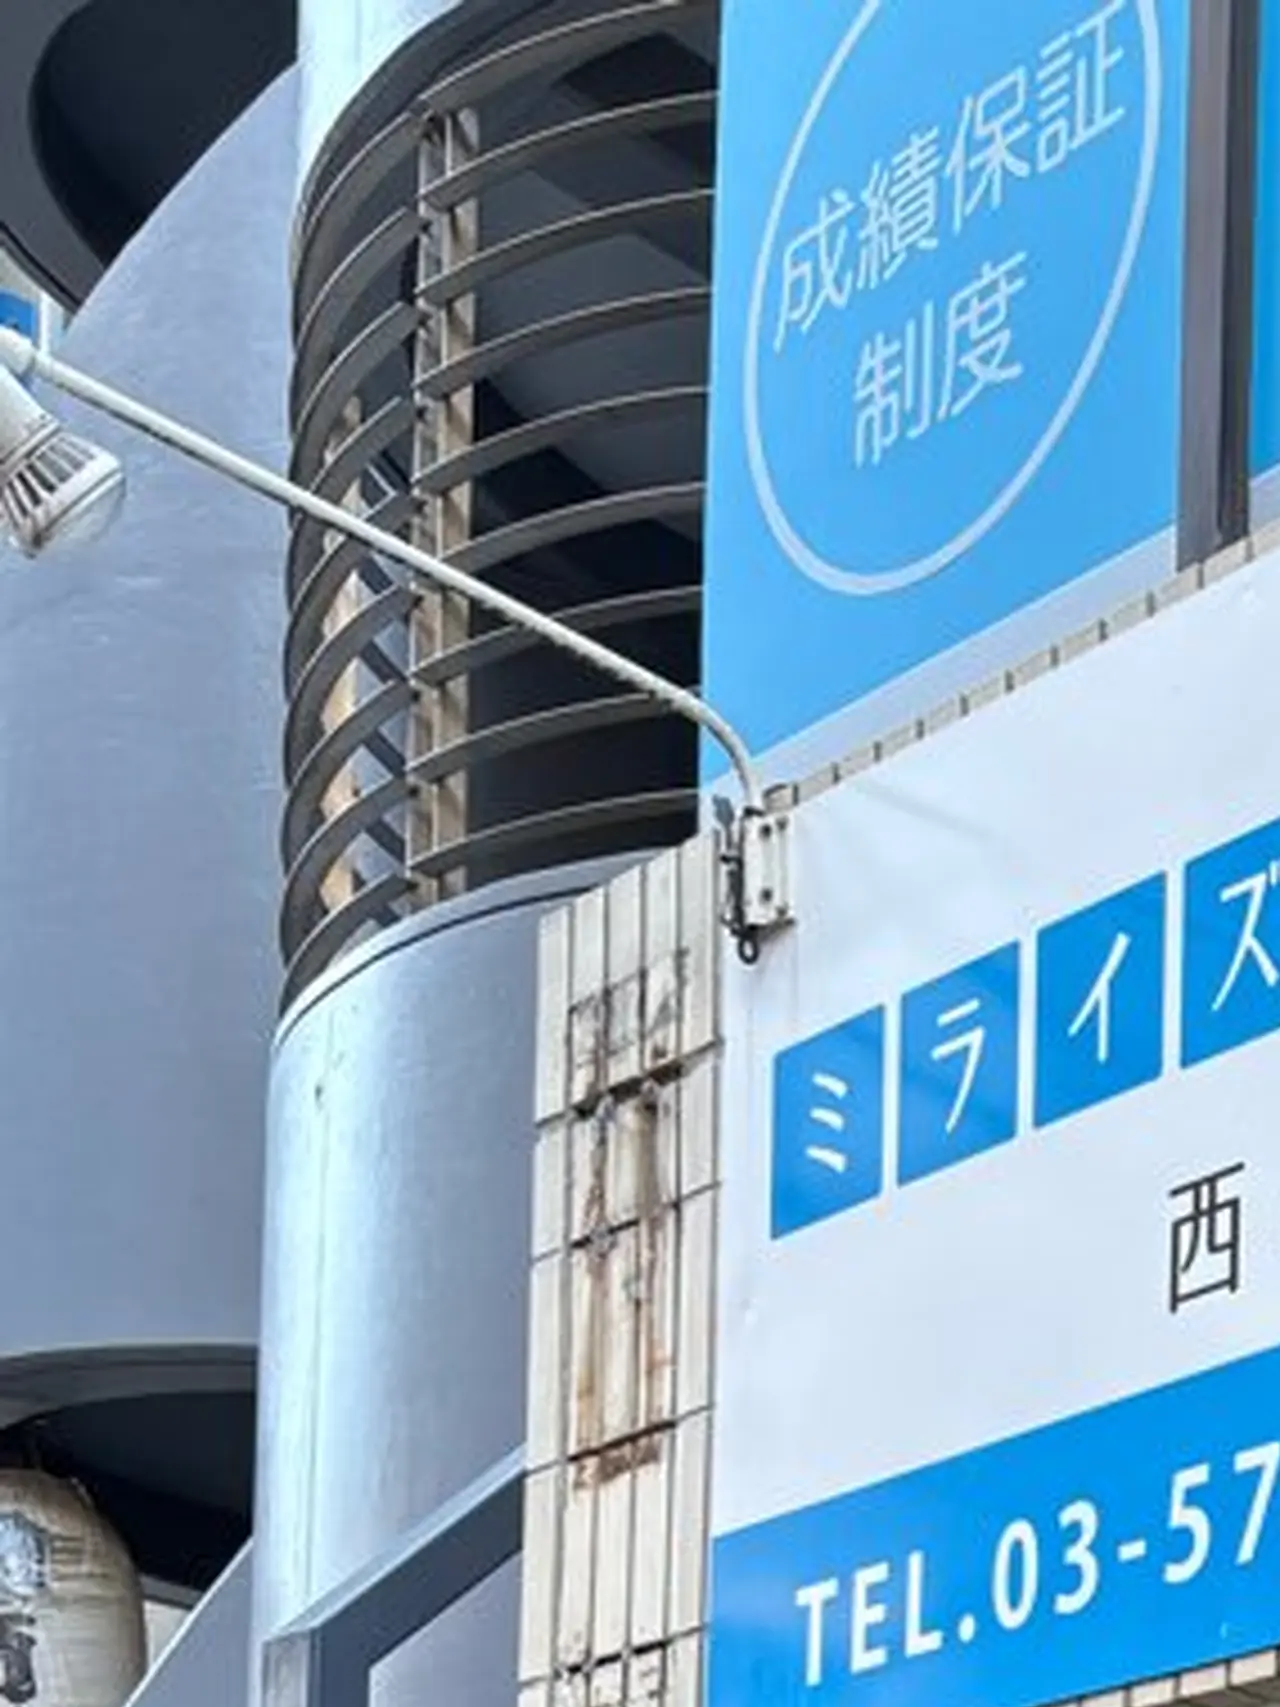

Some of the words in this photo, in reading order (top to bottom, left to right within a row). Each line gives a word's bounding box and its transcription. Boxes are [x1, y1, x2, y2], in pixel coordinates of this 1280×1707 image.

[772, 20, 1130, 354] 成績保証
[850, 248, 1028, 468] 制度
